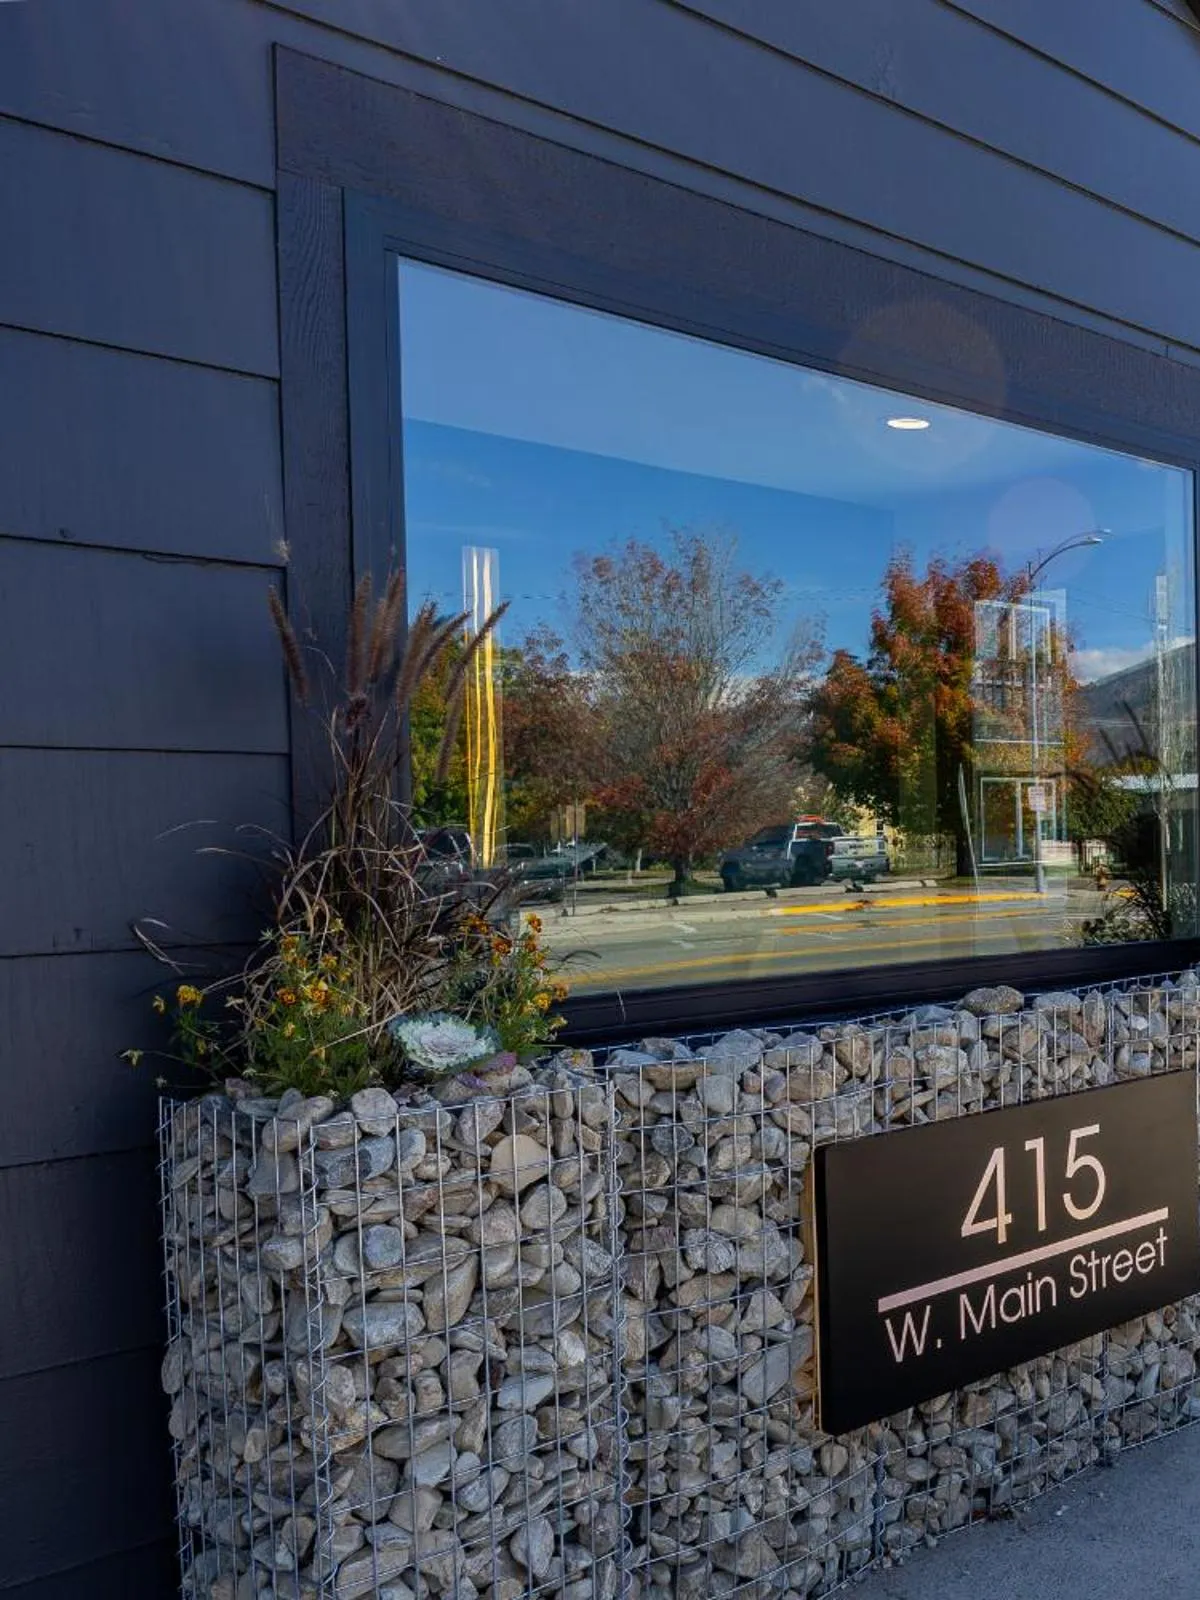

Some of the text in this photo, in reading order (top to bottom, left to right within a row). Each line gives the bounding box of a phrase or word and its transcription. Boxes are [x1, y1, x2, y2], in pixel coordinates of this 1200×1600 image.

[961, 1123, 1107, 1245] 415
[884, 1228, 1169, 1363] W. Main Street
